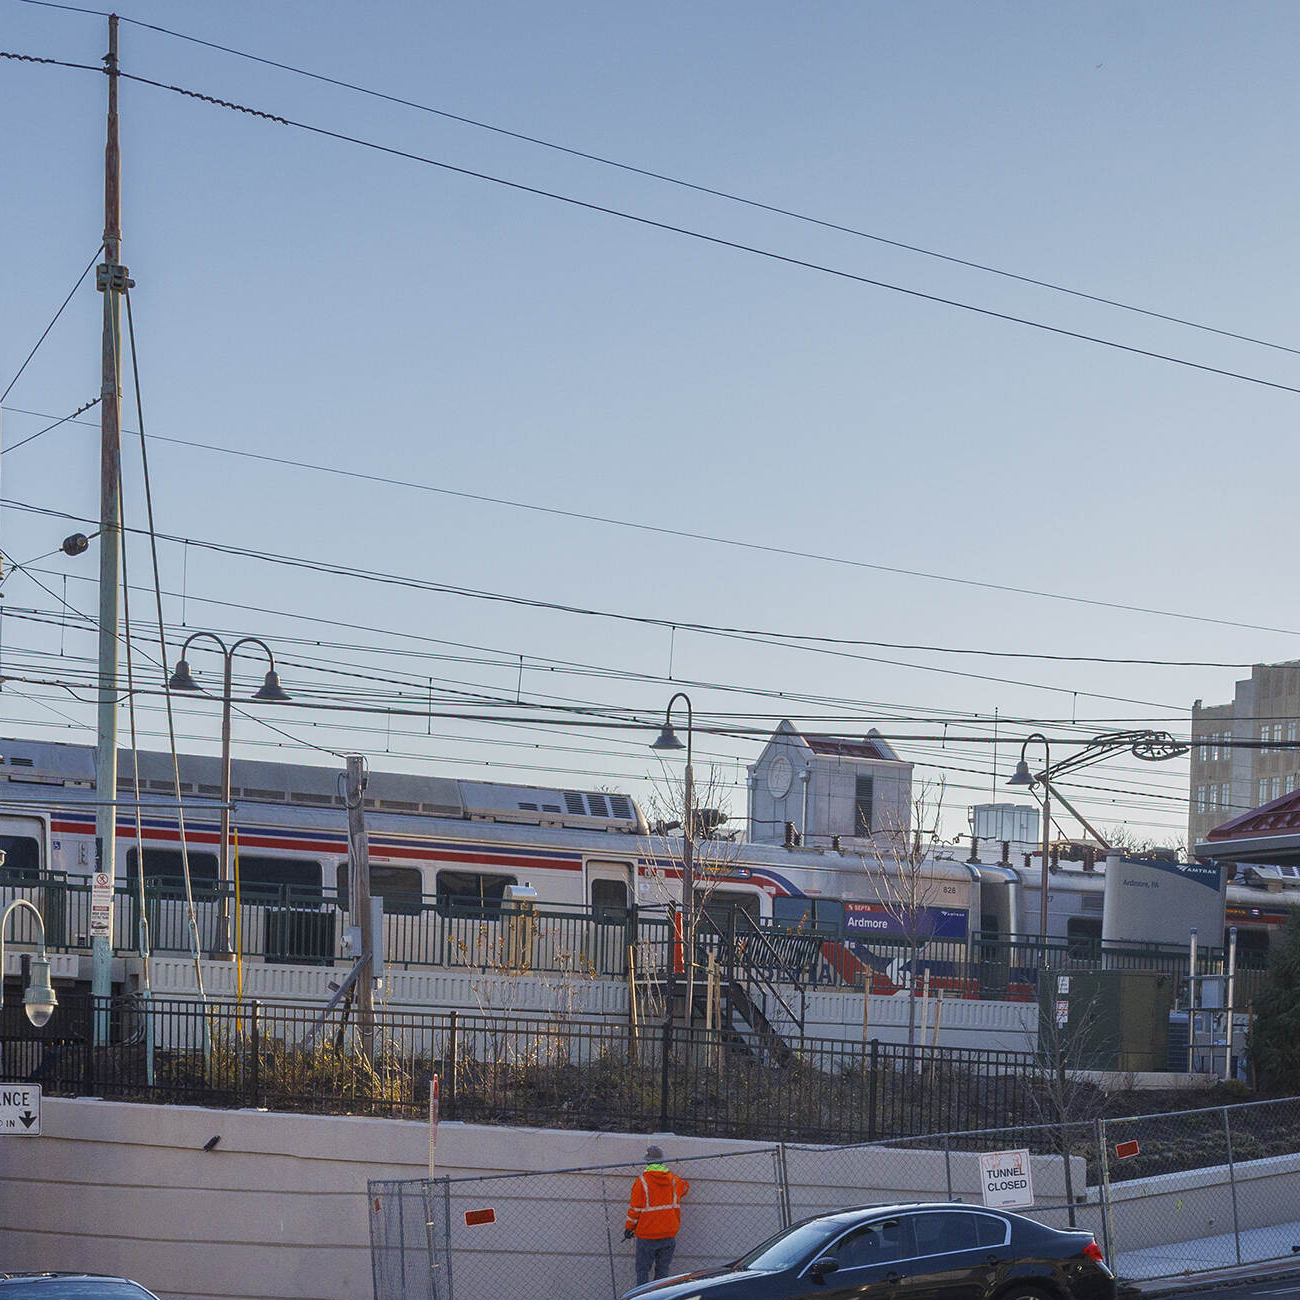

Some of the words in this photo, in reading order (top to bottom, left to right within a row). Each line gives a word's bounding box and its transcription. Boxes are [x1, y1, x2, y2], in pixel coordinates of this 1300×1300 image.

[1186, 867, 1217, 875] AMTRAK
[942, 886, 957, 894] 828
[847, 916, 888, 929] Ardmore
[6, 1119, 16, 1128] IN
[986, 1167, 1026, 1179] TUNNEL
[987, 1179, 1027, 1192] CLOSED
